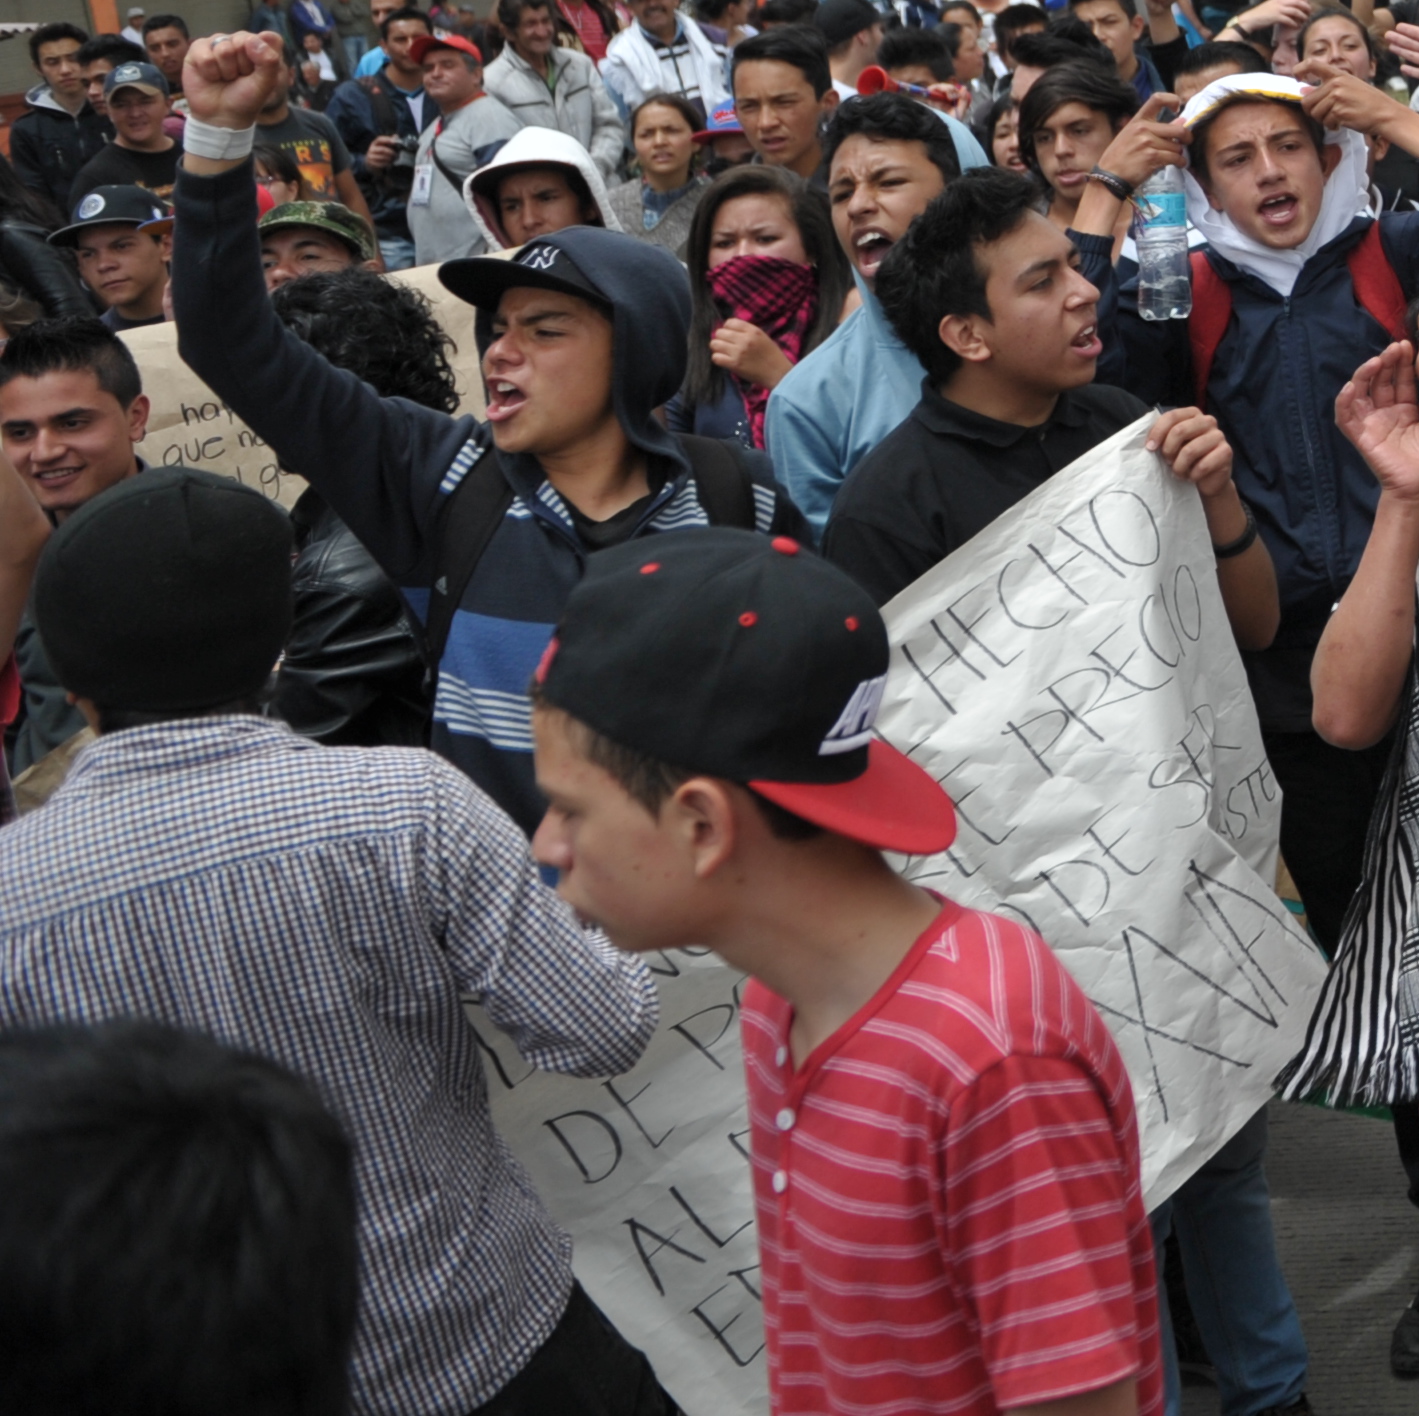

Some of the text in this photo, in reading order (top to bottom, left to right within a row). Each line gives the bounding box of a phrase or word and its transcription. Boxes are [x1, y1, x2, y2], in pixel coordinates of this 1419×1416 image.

[902, 490, 1161, 714] HECHO
[1001, 565, 1201, 778] PRECIO
[1148, 703, 1242, 830] SER
